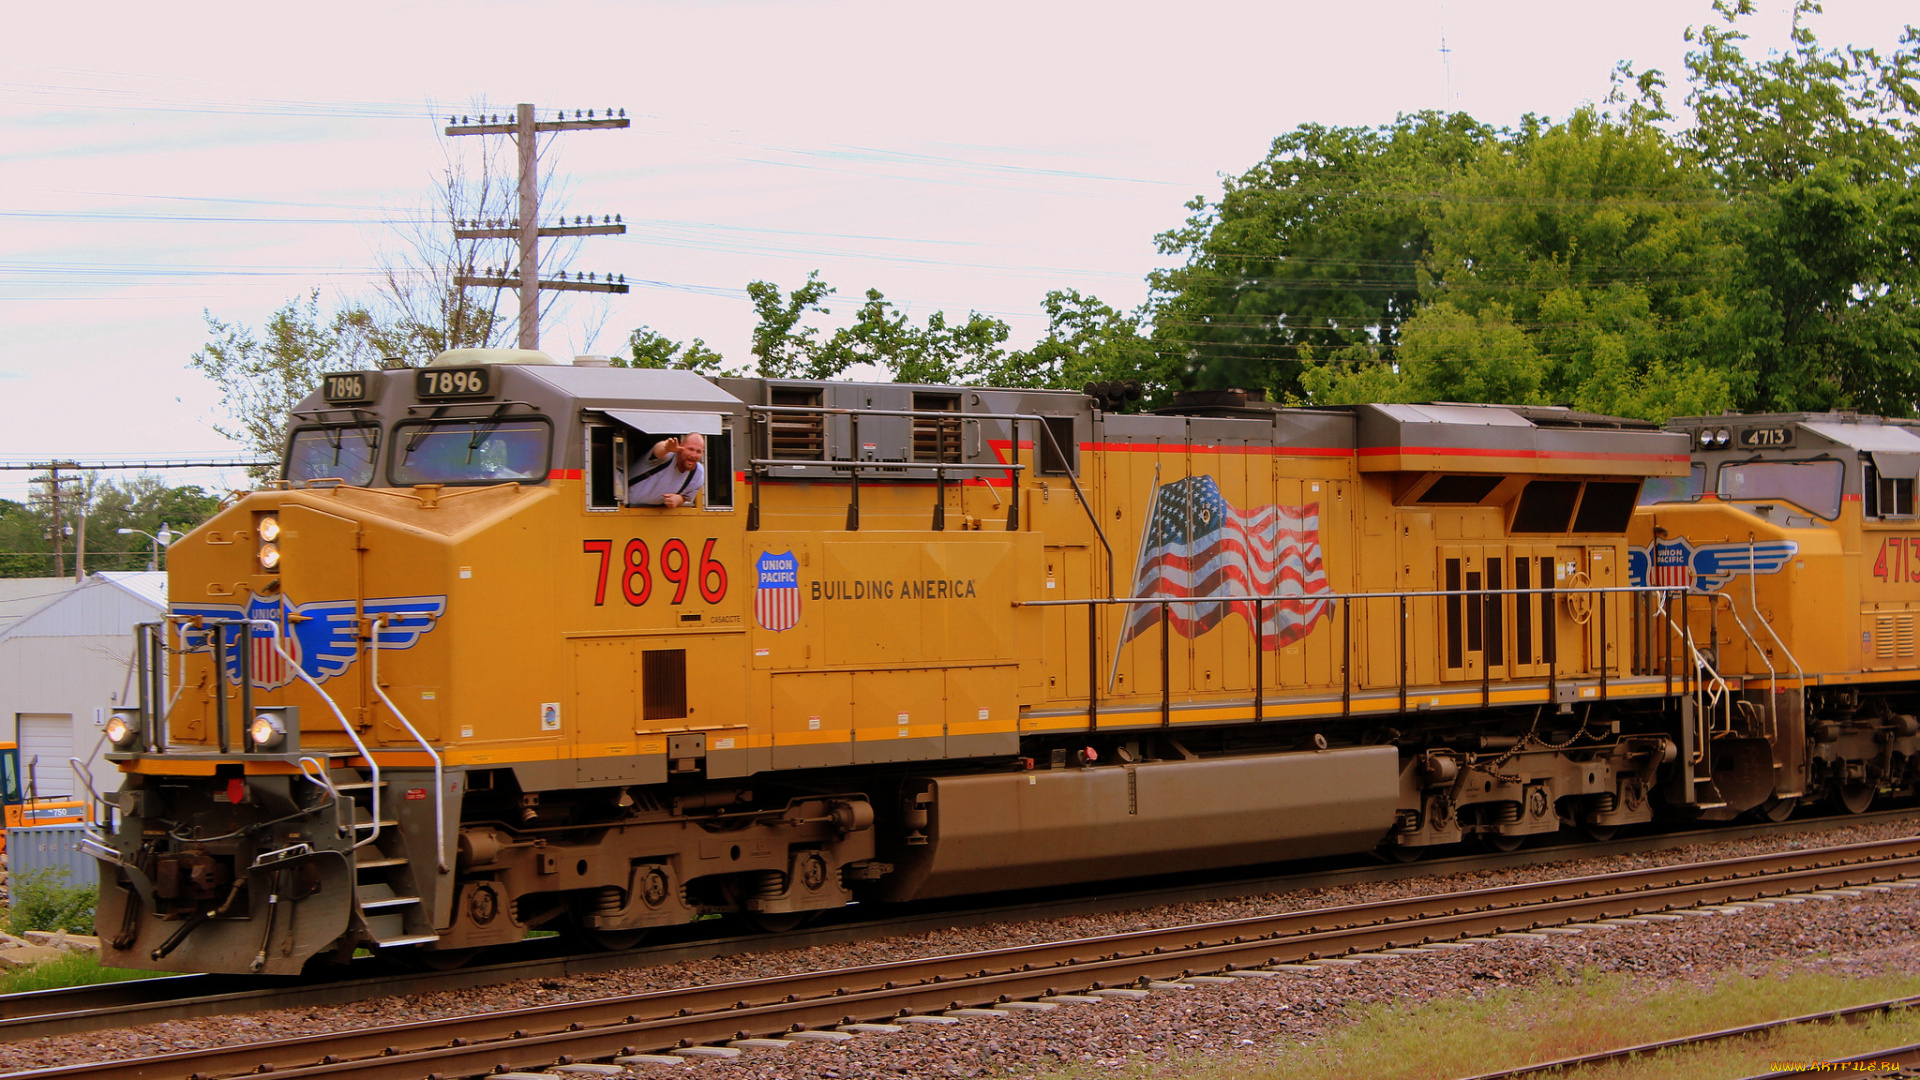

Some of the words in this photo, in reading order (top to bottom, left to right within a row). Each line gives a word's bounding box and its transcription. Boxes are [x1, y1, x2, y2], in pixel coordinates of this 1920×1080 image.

[328, 376, 362, 399] 7896
[425, 371, 482, 394] 7896
[1748, 429, 1785, 445] 4713
[762, 560, 793, 570] UNION
[1873, 536, 1920, 583] 4713
[583, 538, 728, 607] 7896
[761, 571, 795, 583] PACIFIC
[811, 580, 894, 600] BUILDING
[900, 579, 976, 599] AMERICA
